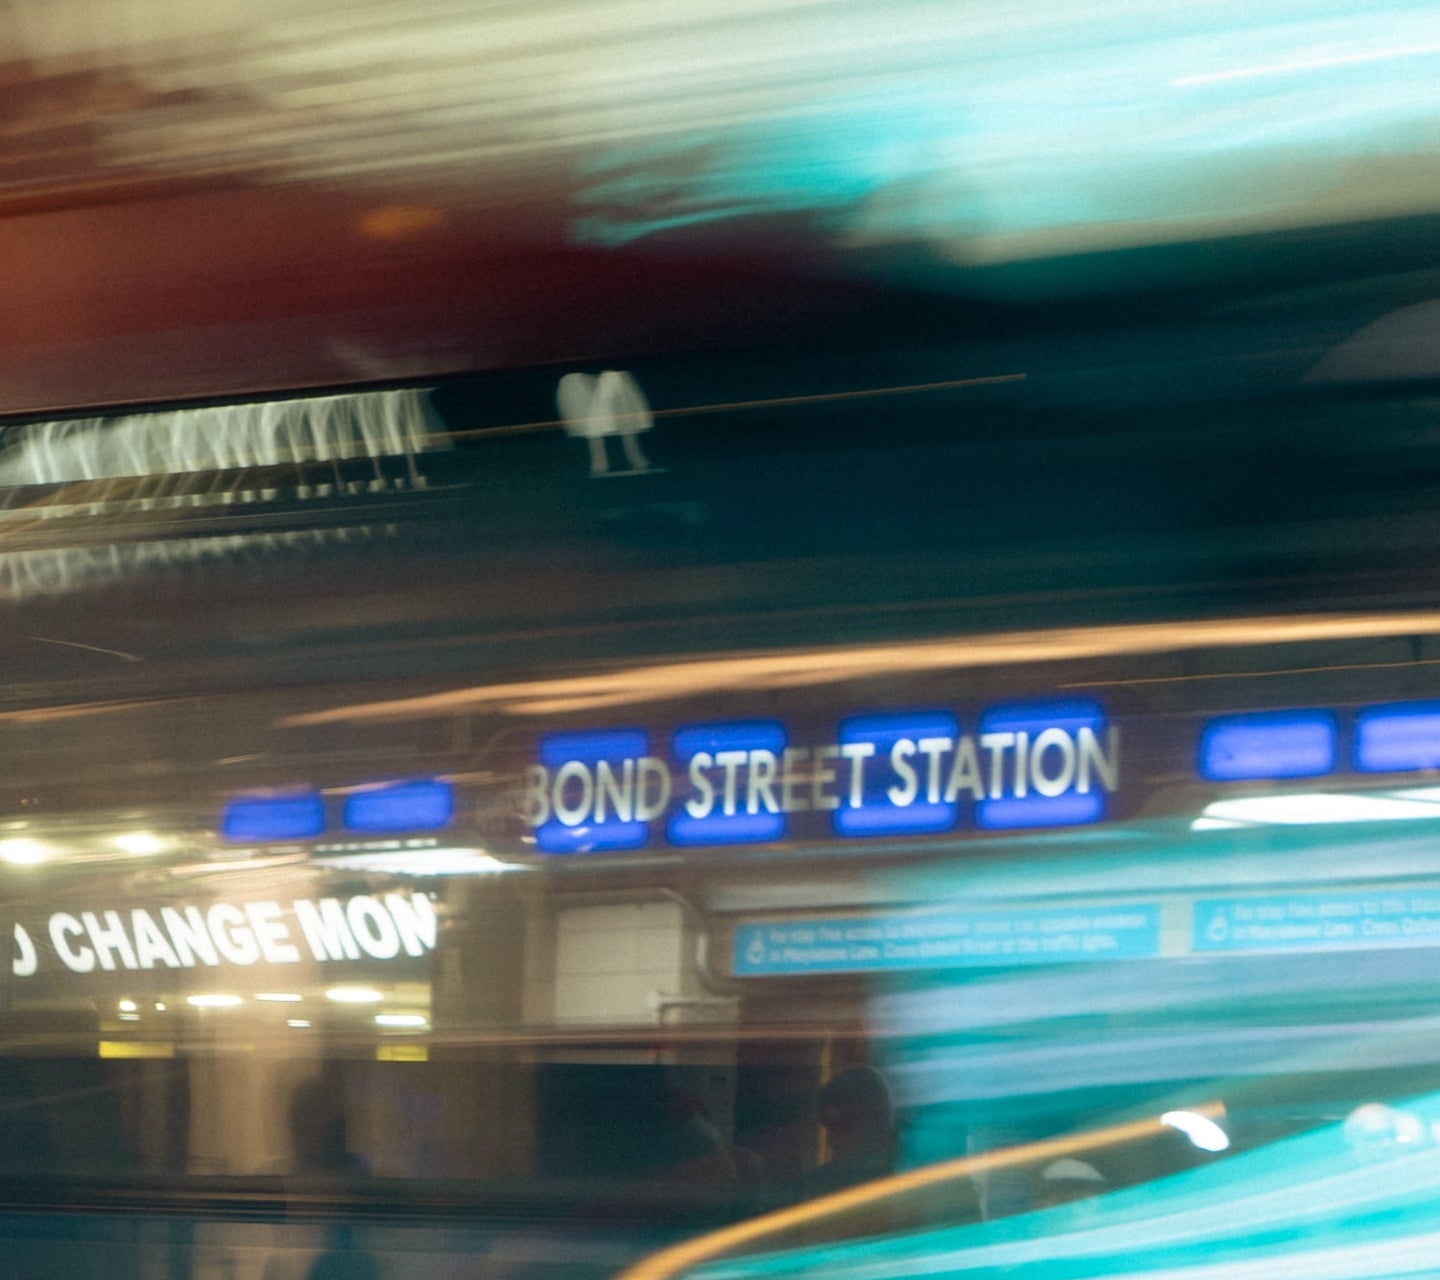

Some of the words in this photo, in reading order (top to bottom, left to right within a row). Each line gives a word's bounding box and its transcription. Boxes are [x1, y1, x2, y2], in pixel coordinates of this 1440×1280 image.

[523, 756, 672, 827] BOND
[685, 743, 875, 820] STREET
[888, 727, 1119, 808] STATION
[48, 901, 300, 974] CHANGE
